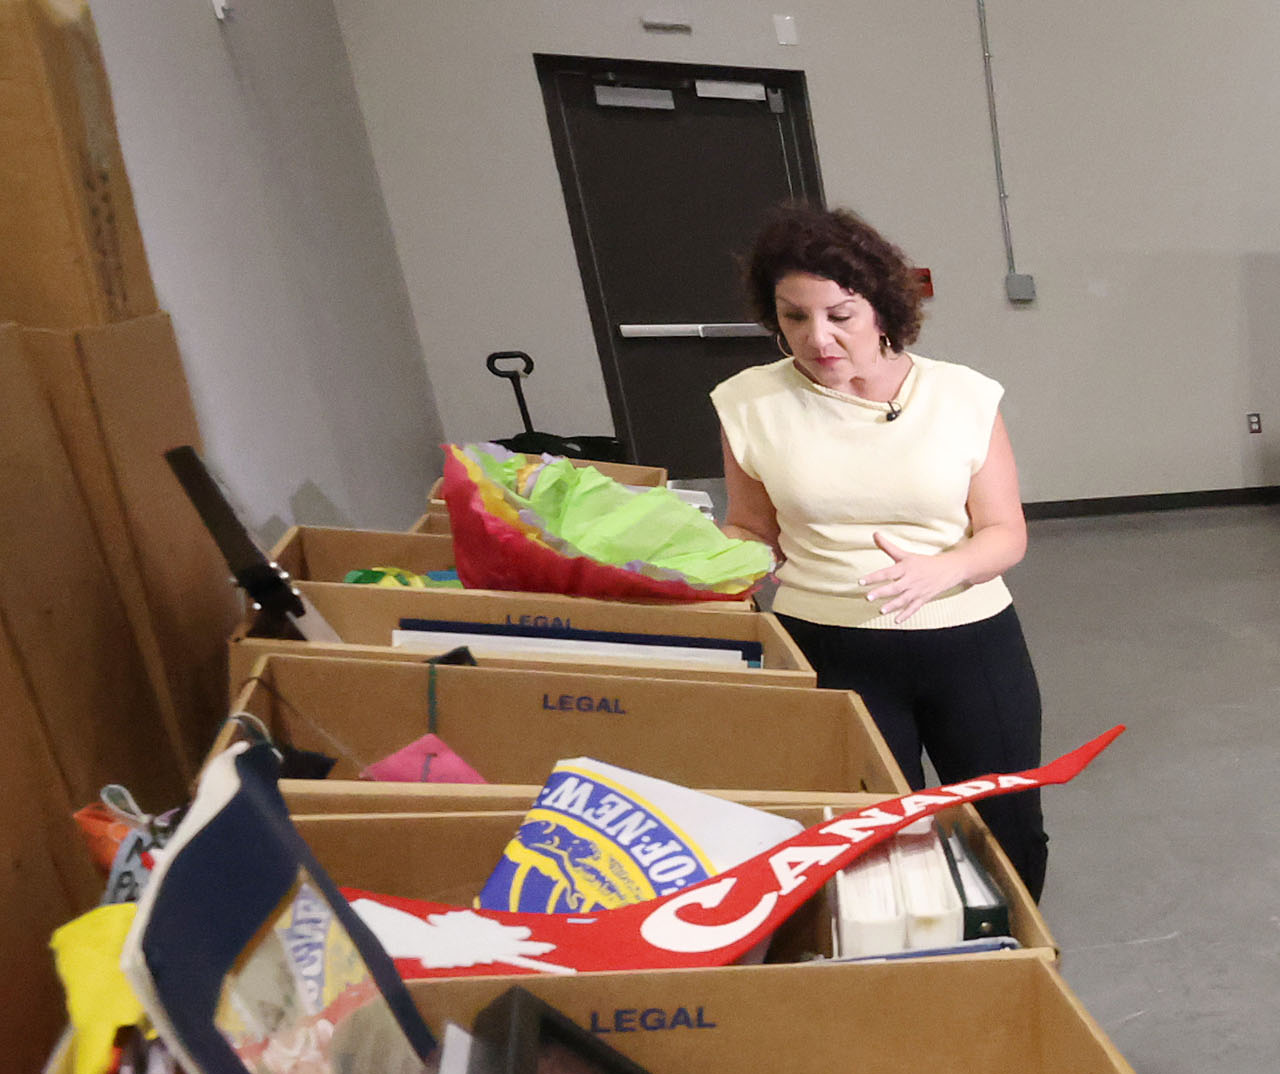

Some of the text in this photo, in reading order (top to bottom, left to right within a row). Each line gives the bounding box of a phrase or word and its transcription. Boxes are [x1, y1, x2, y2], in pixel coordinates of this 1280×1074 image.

[542, 693, 626, 715] LEGAL
[639, 773, 1039, 954] CANADA
[590, 1005, 717, 1033] LEGAL
